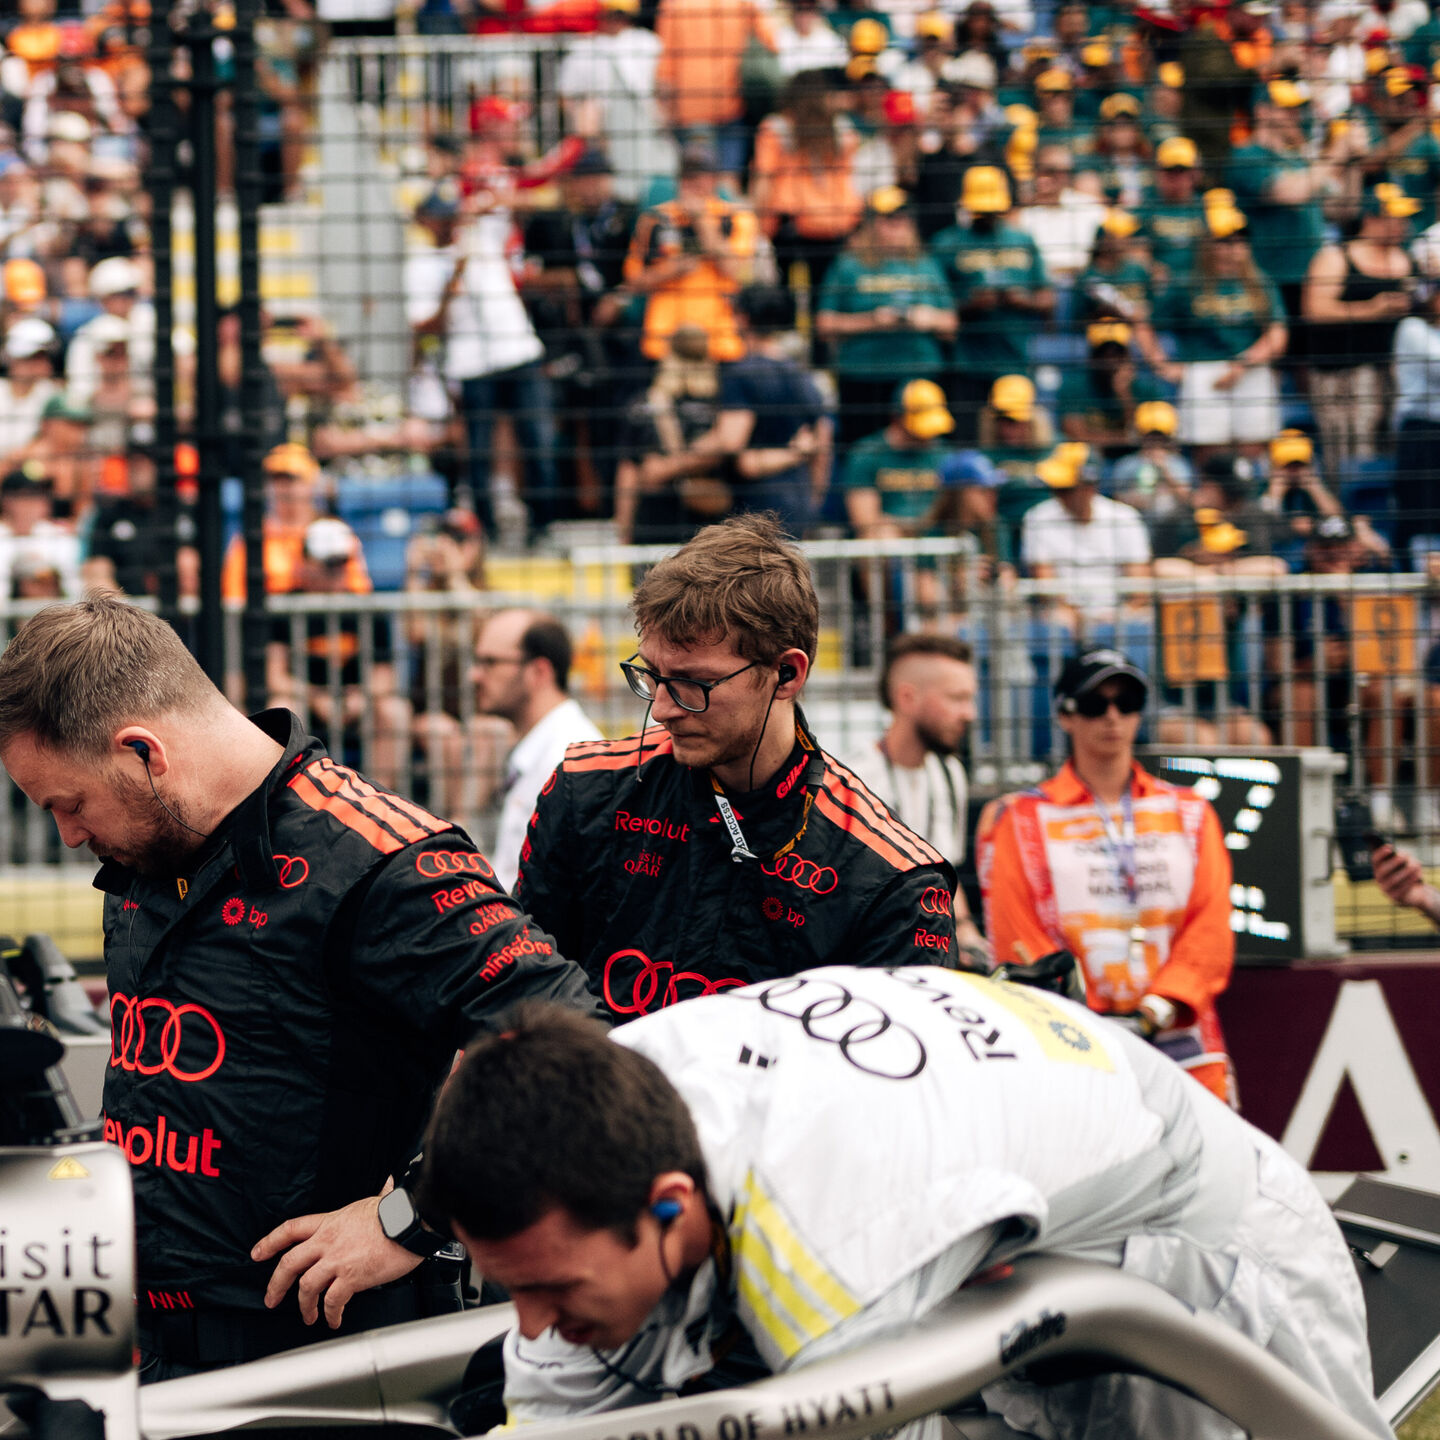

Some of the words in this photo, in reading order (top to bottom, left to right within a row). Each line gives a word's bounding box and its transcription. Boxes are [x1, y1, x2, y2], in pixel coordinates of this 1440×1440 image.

[615, 809, 691, 843] Revolut
[720, 802, 740, 836] ACCESS
[248, 905, 269, 929] bp
[469, 906, 517, 935] QATAR
[786, 908, 806, 928] bp
[103, 1109, 222, 1178] evolut
[781, 1380, 896, 1436] HYATT
